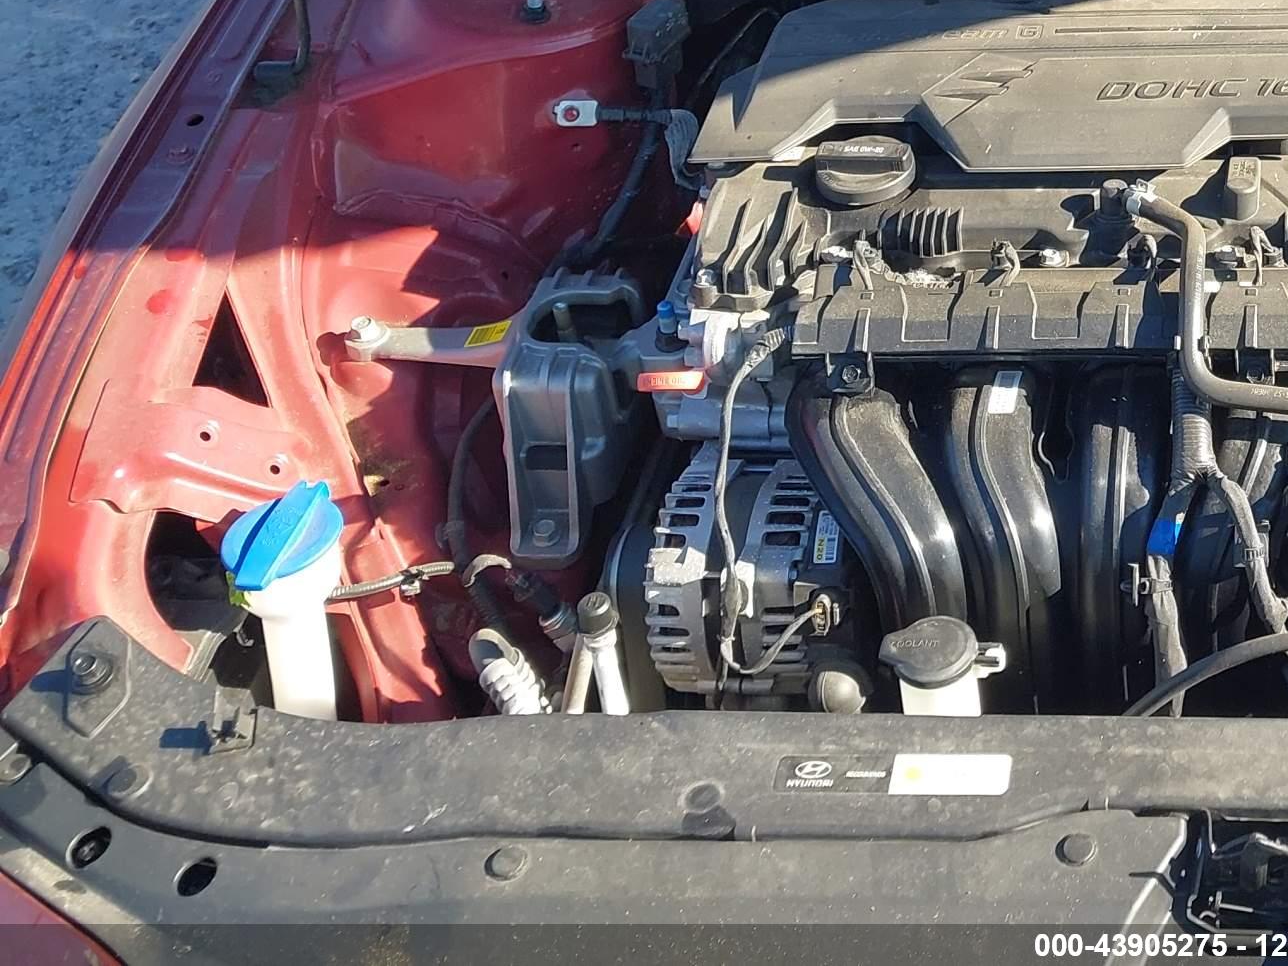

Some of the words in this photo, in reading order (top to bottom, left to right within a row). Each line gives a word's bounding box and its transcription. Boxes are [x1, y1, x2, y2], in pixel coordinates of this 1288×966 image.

[1096, 77, 1248, 101] DOHC
[890, 639, 940, 649] COOLANT
[786, 778, 834, 788] HYUNDAI
